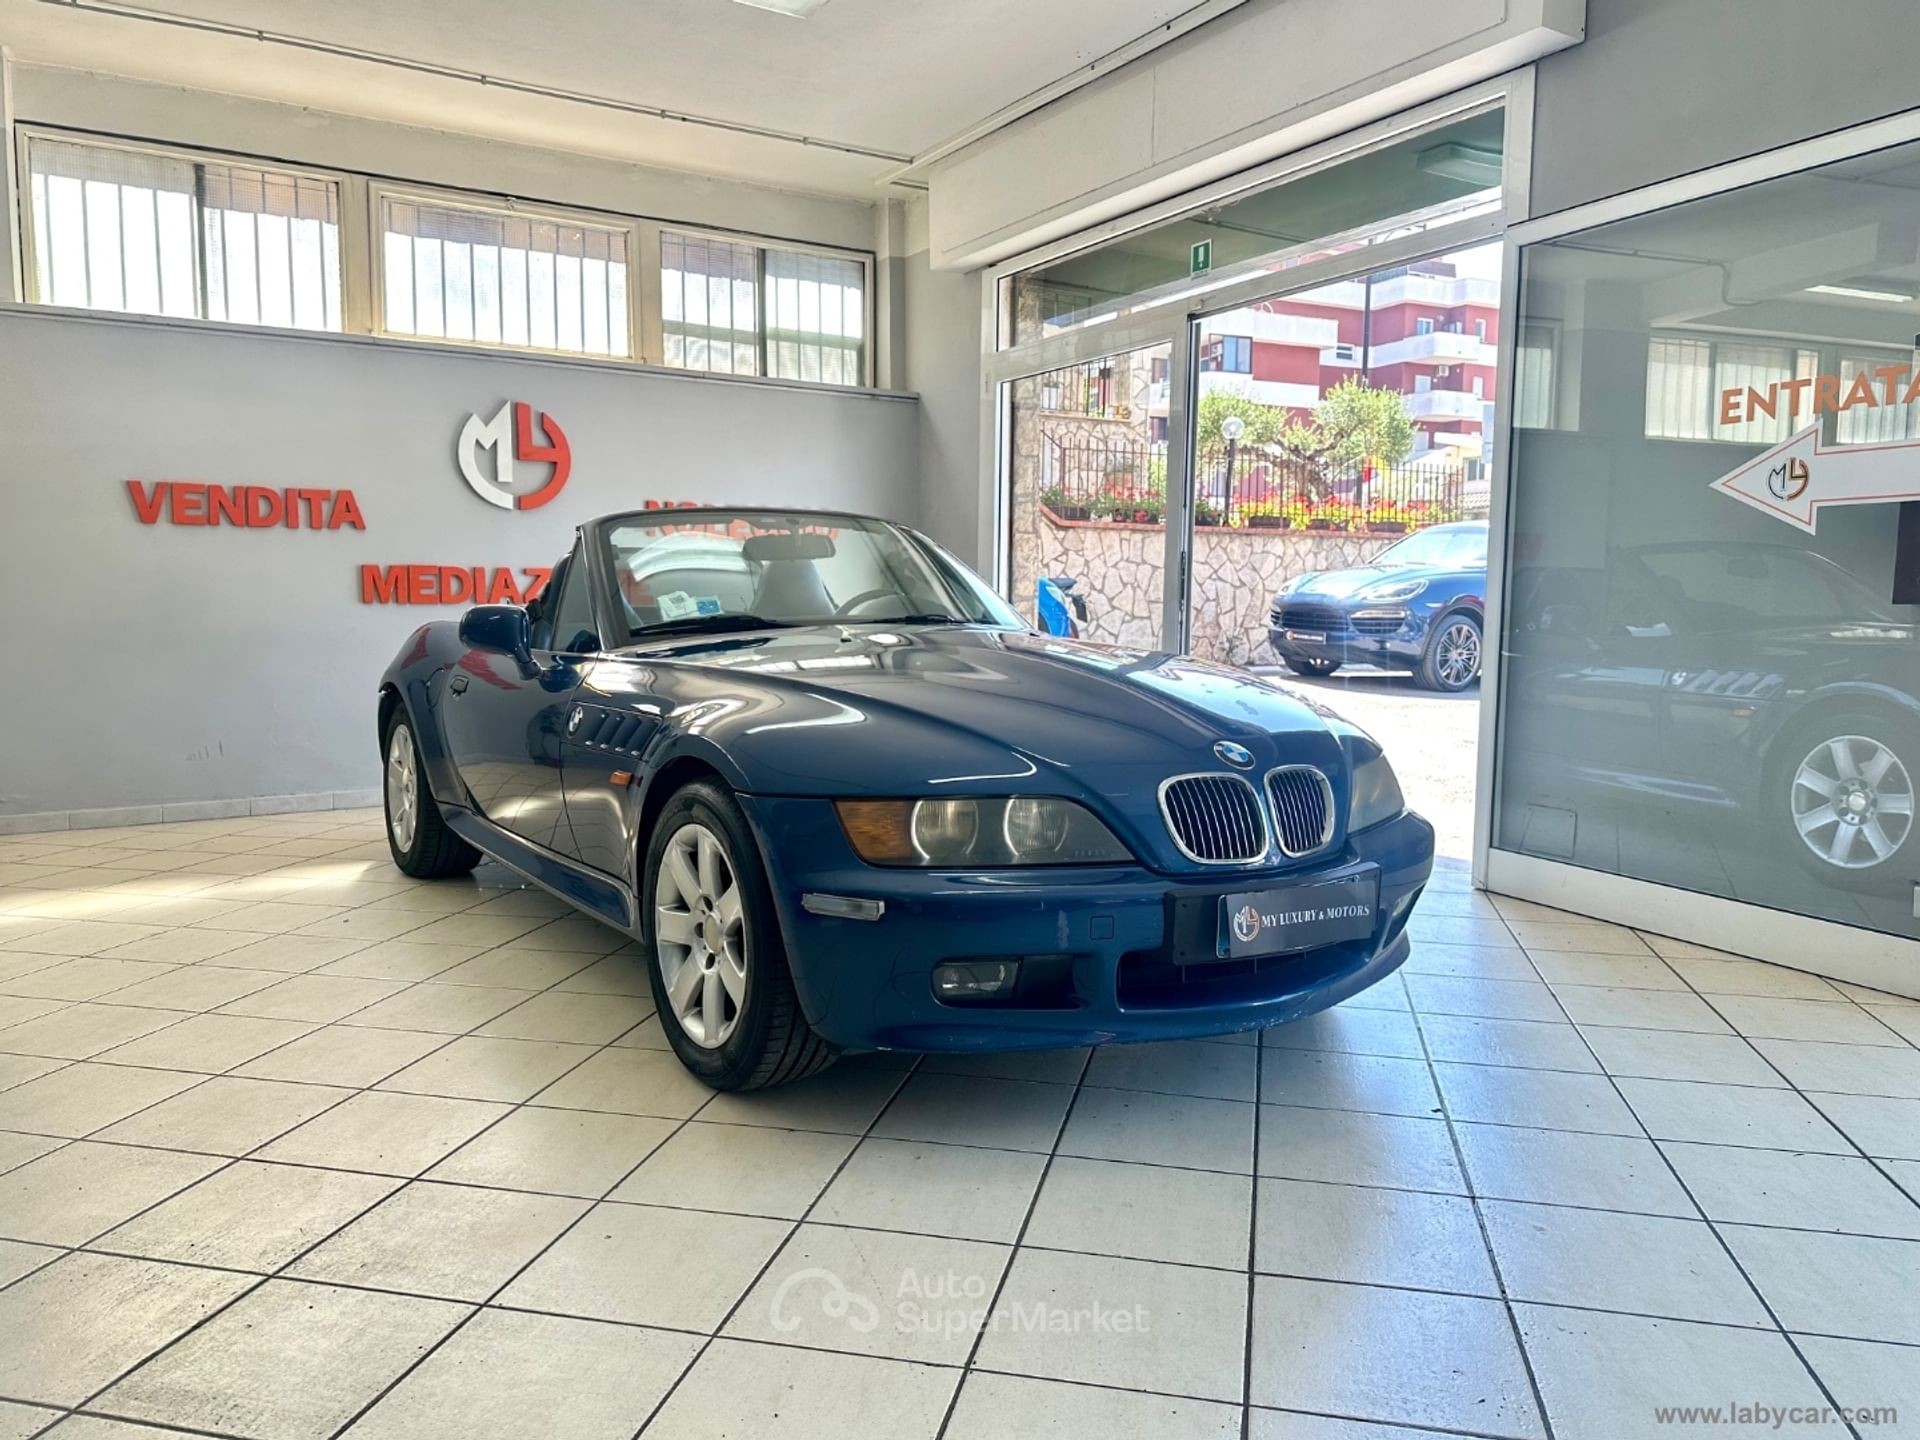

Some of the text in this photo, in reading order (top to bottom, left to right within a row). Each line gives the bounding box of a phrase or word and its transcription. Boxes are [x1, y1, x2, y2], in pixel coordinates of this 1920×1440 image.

[127, 480, 366, 531] VENDITA
[360, 564, 553, 605] MEDIAZ
[1261, 904, 1371, 928] MY LUXURY & MOTORS
